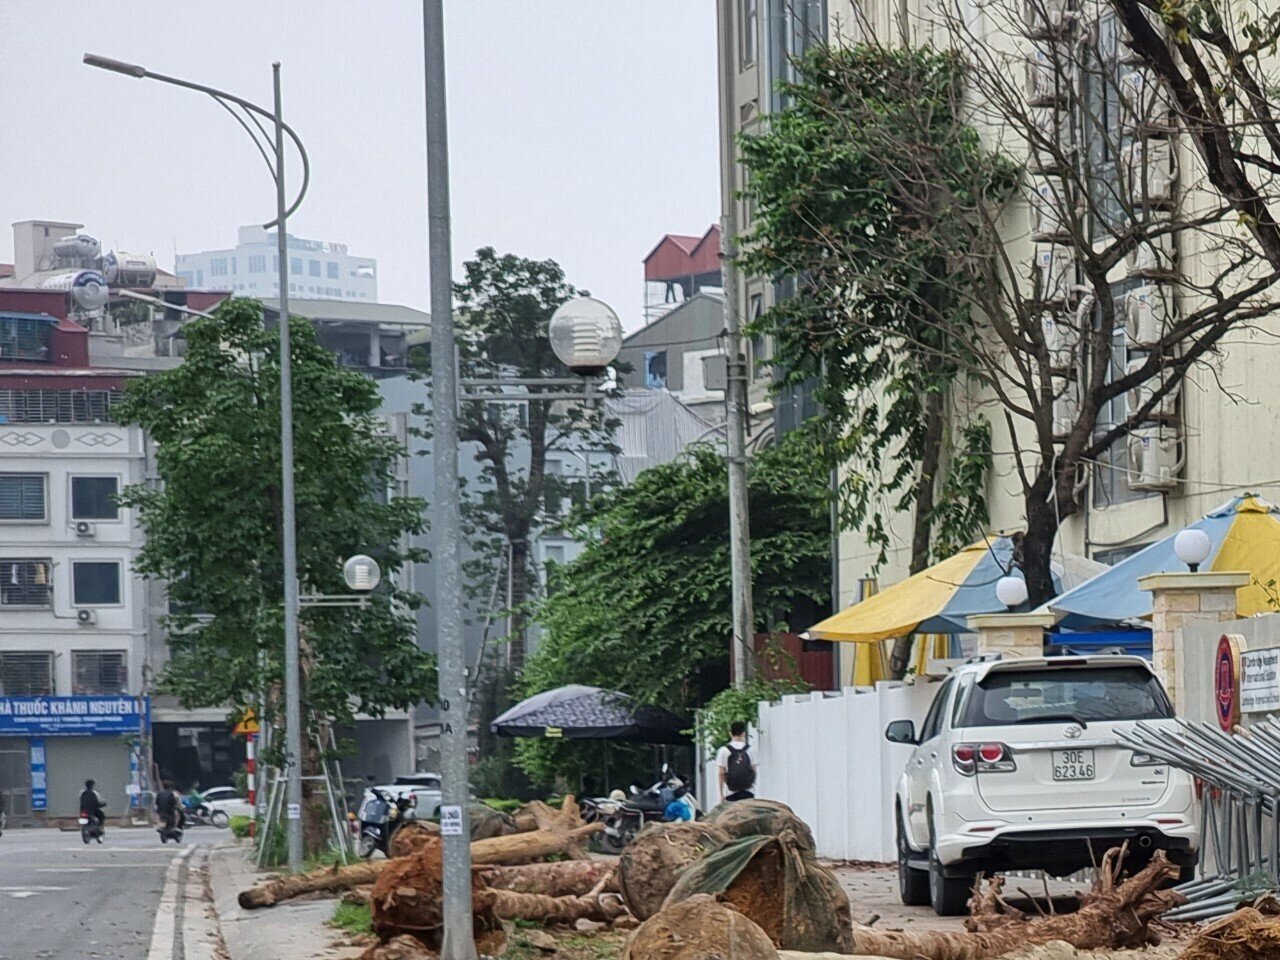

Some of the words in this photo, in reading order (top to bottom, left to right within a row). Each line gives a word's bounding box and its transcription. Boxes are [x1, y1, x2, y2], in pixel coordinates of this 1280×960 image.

[0, 697, 12, 715] HÀ
[13, 697, 48, 715] THUỐC
[1062, 751, 1084, 764] 30E
[1055, 764, 1093, 778] 623.46
